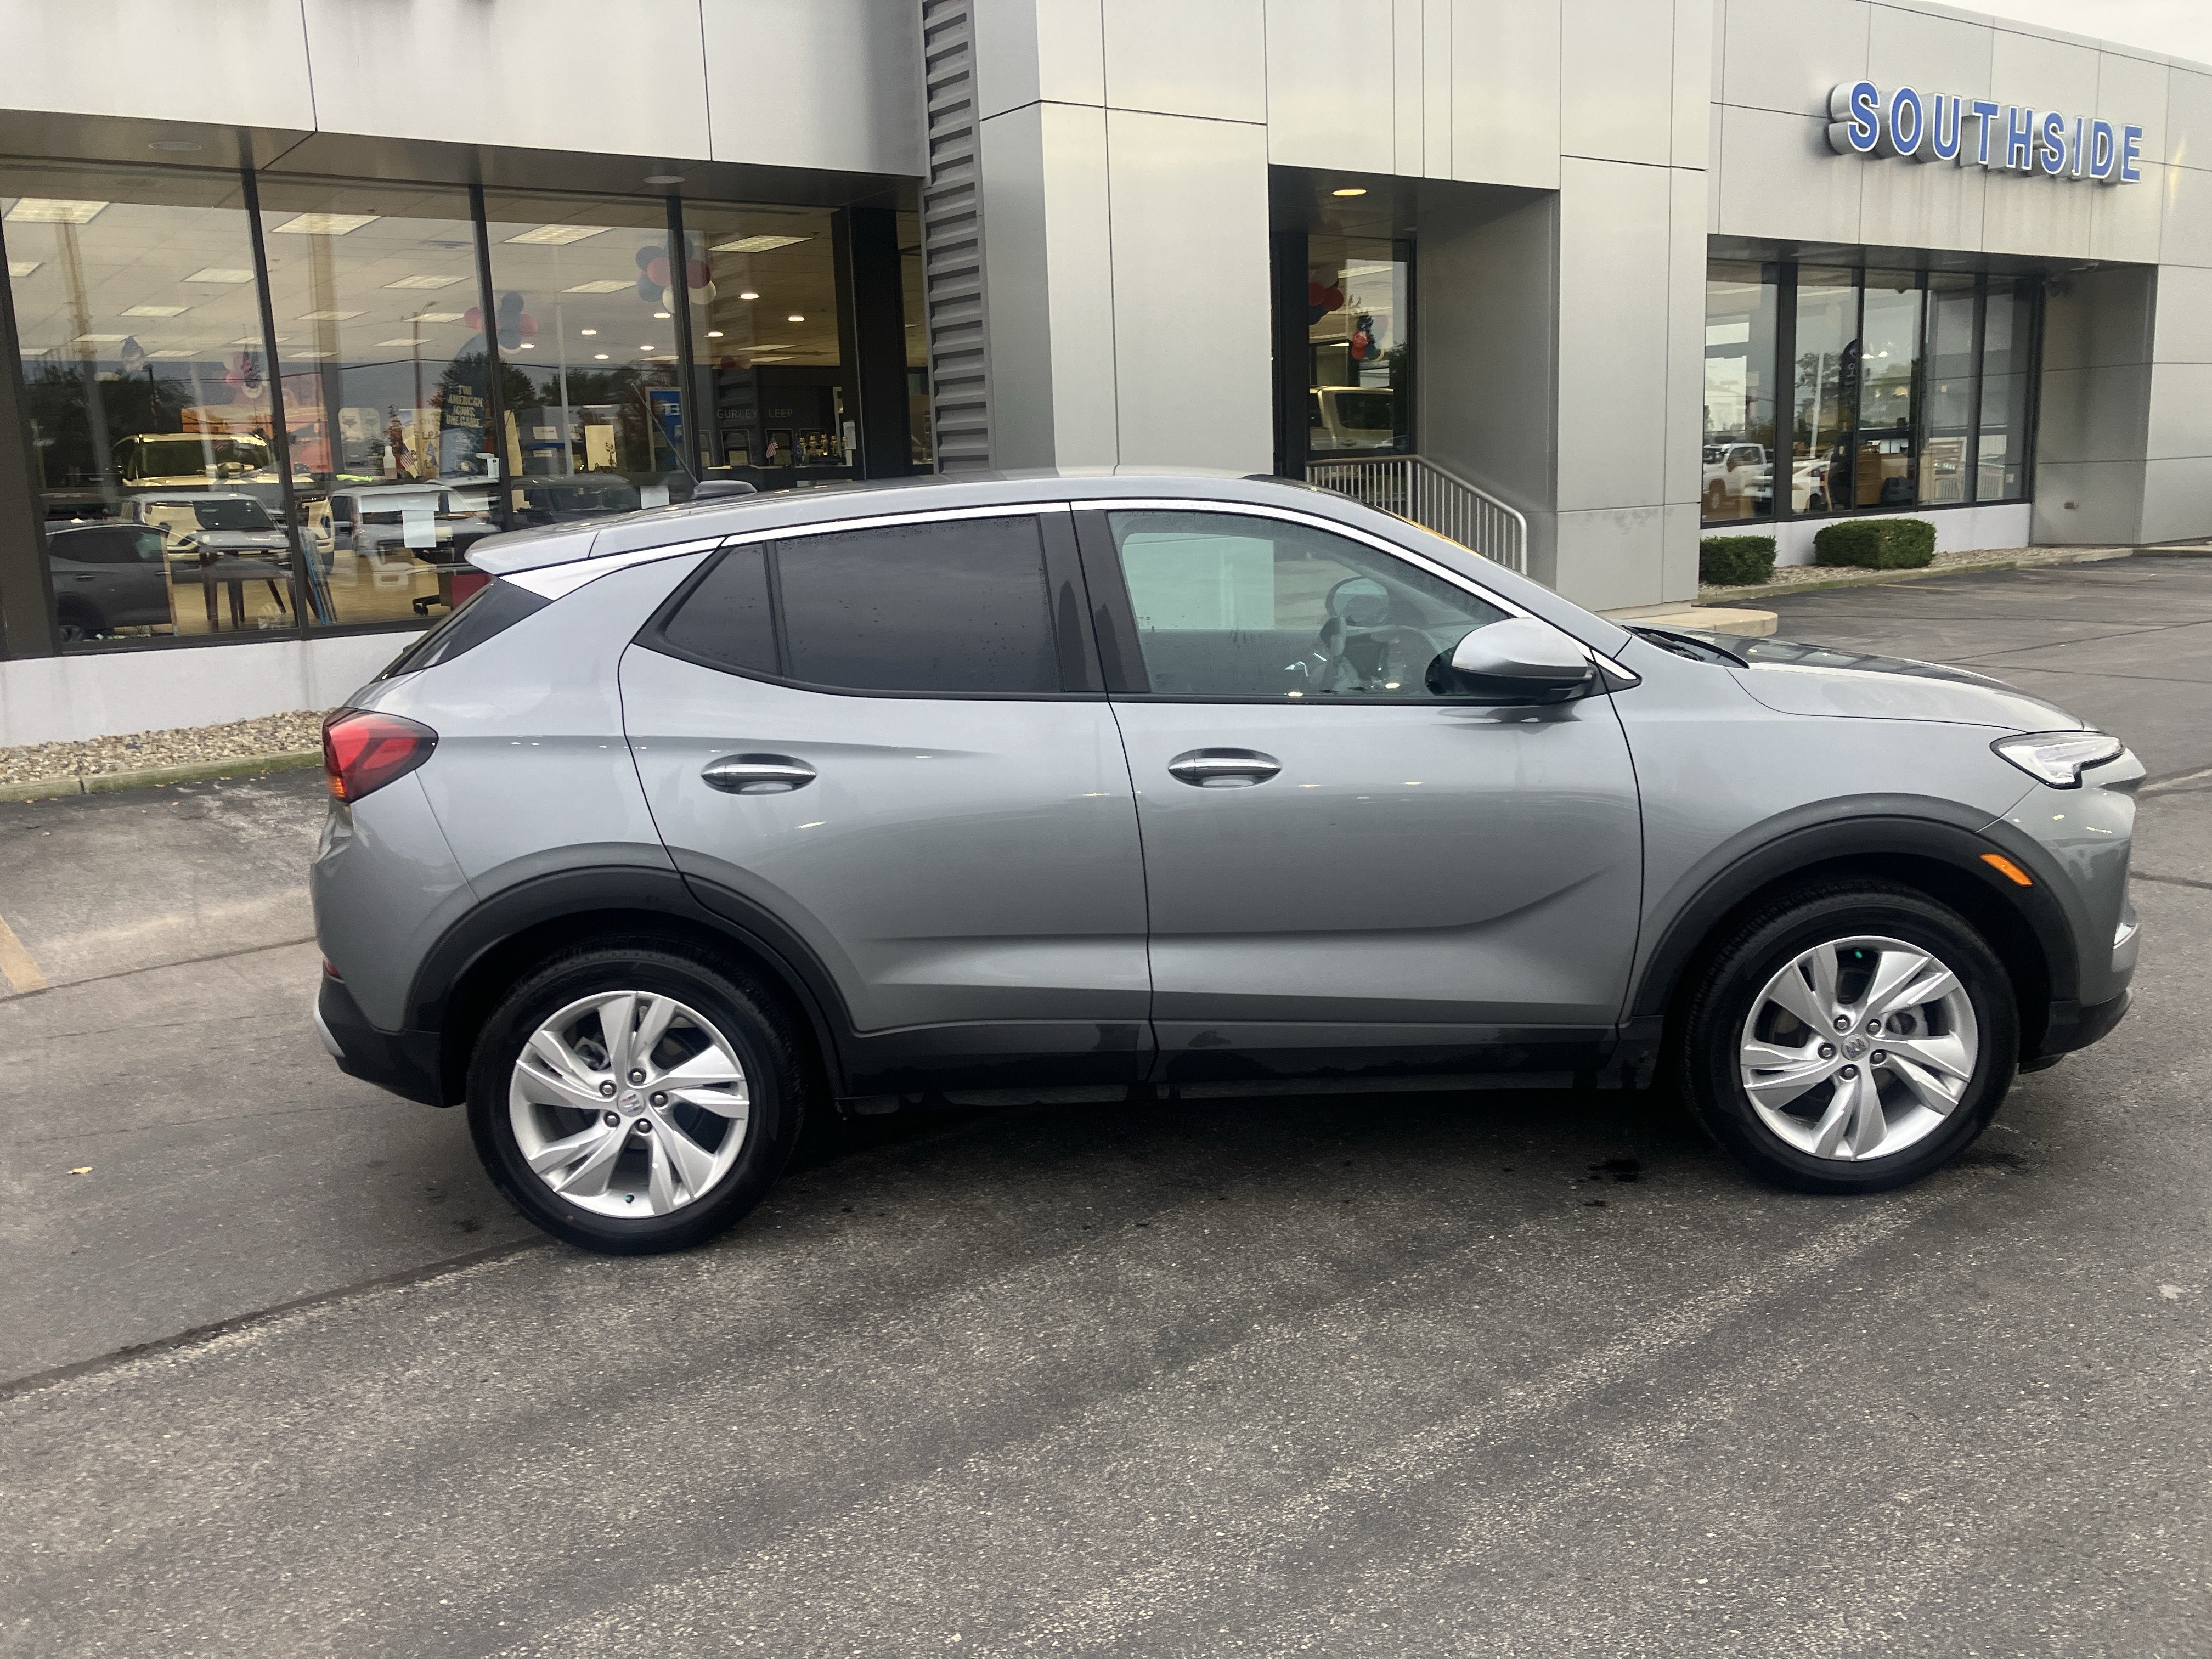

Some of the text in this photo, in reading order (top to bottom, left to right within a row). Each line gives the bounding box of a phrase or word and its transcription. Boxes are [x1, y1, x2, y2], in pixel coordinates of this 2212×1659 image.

[1839, 79, 2145, 184] SOUTHSIDE
[448, 394, 483, 407] AMERICAN
[716, 409, 793, 419] GURLEY LEEP
